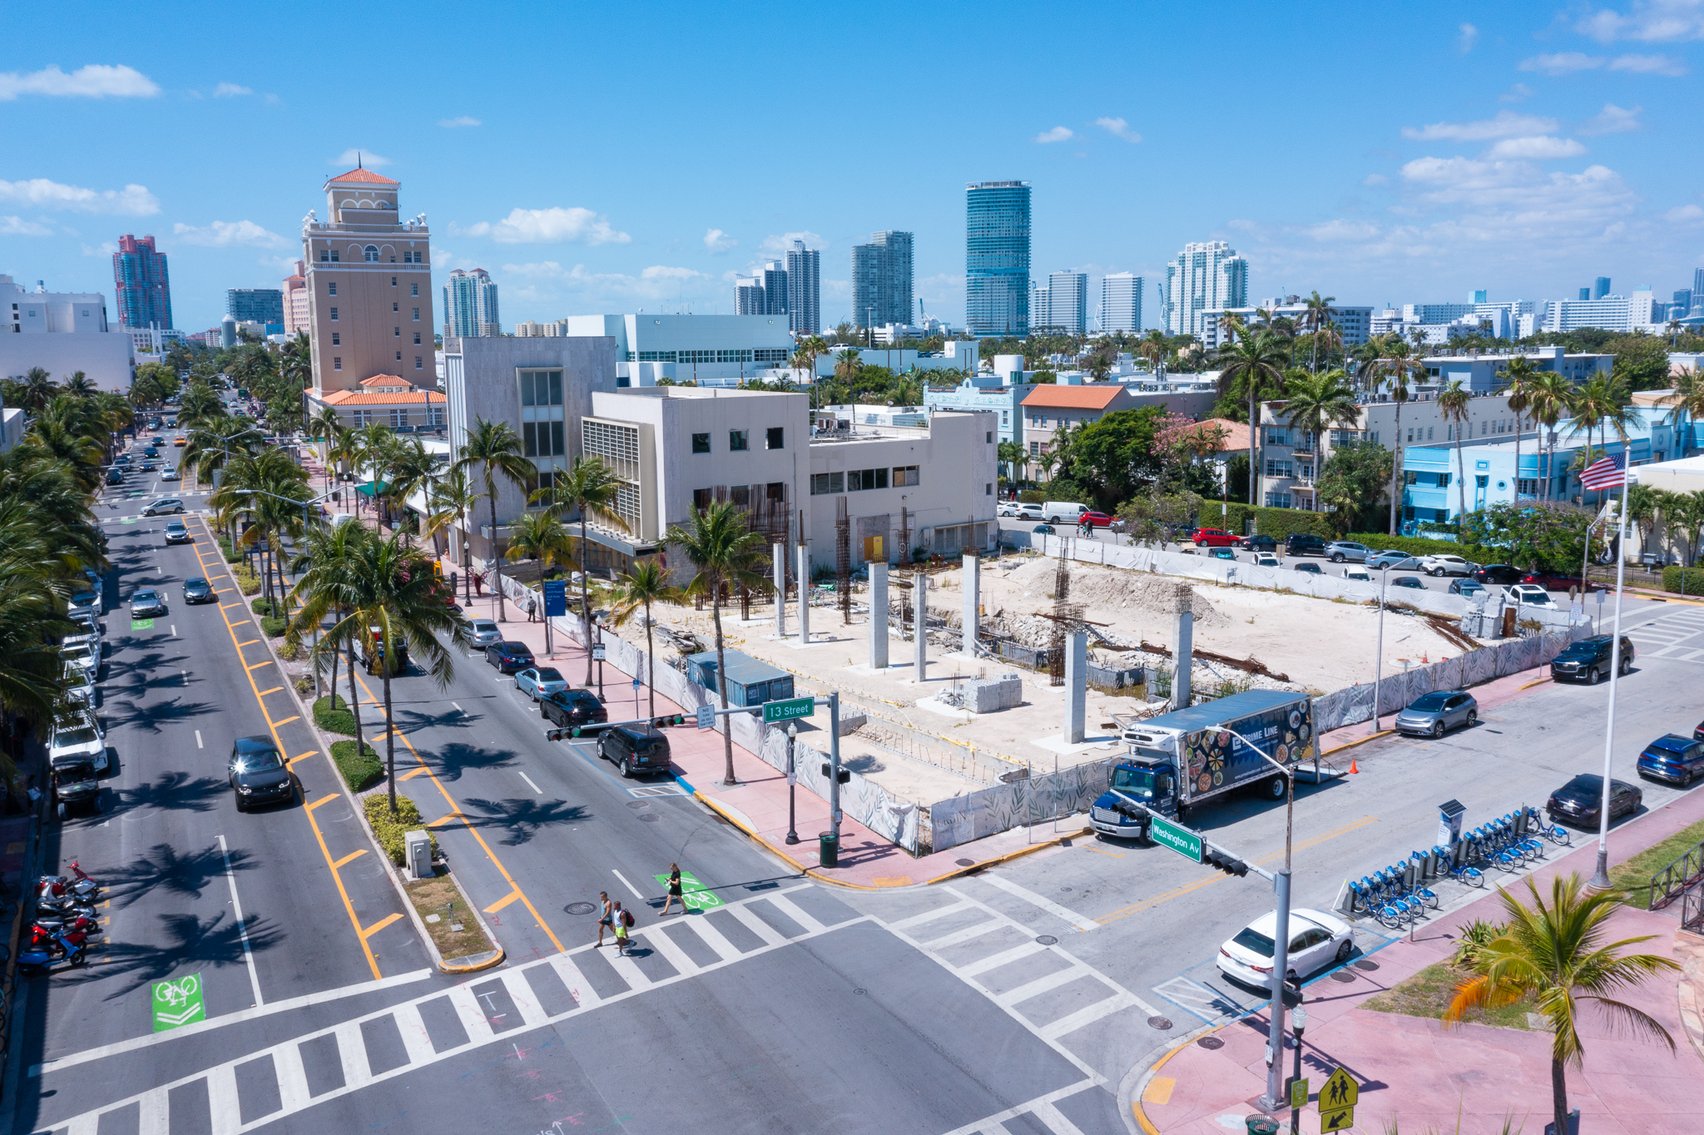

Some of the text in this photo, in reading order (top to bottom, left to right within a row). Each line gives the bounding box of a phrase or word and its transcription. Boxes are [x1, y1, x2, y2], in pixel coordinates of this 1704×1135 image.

[770, 704, 808, 717] 13 Street
[1242, 725, 1278, 744] PRIME LINE
[1153, 824, 1199, 854] Washington Av
